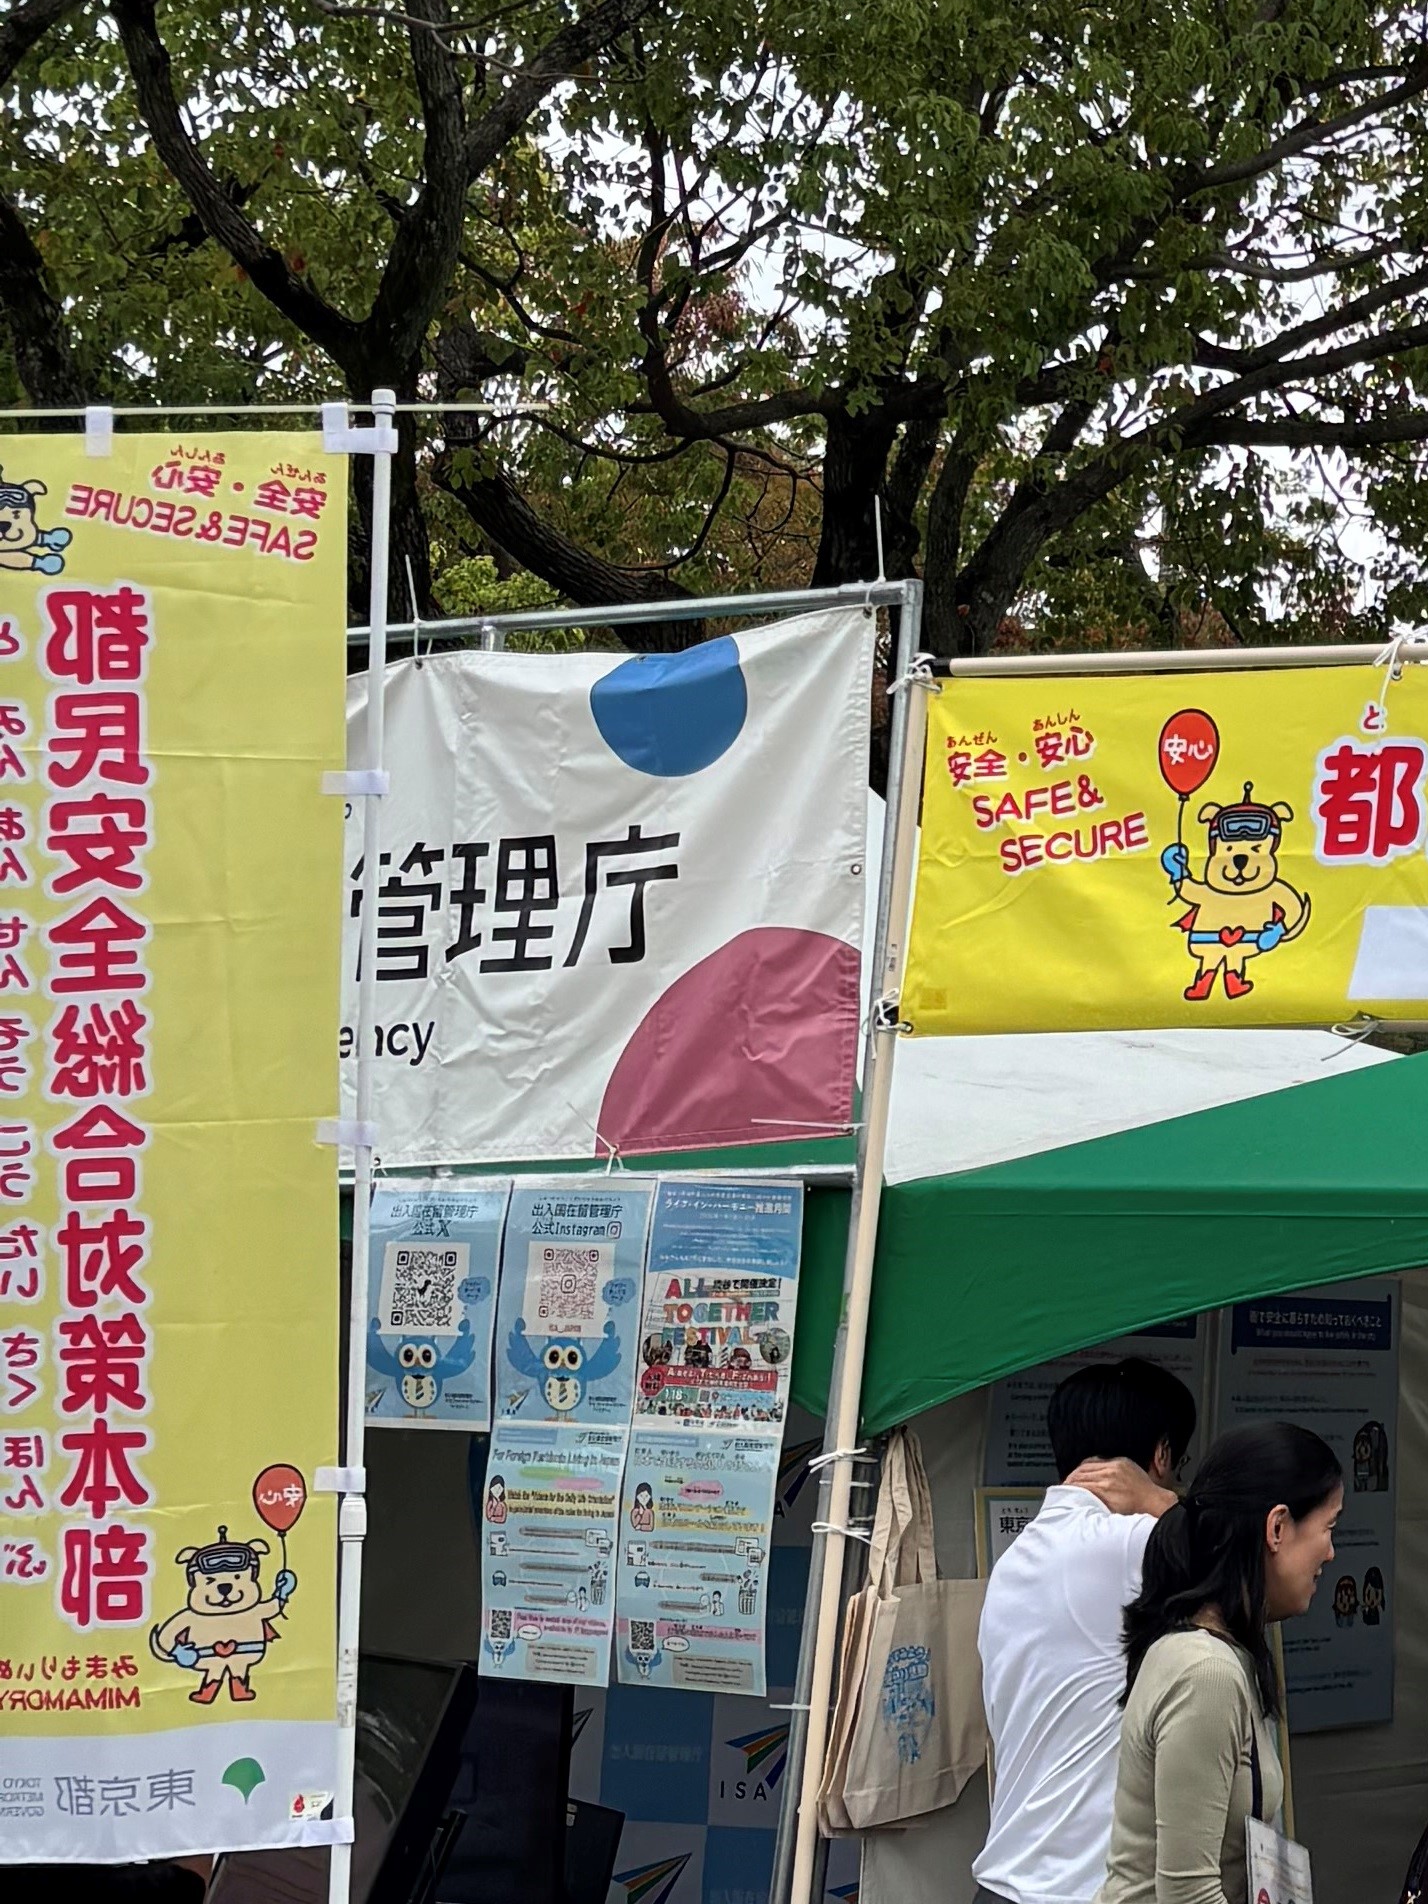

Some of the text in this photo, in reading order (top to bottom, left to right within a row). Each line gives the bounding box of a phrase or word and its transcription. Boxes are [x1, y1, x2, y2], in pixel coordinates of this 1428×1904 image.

[947, 725, 1094, 788] 安全・安心
[1163, 736, 1213, 764] 安心
[973, 773, 1106, 830] SAFE&
[1000, 812, 1149, 873] SECURE
[350, 825, 681, 982] 管理庁
[665, 1278, 711, 1299] ALL
[663, 1301, 780, 1323] TOGETHER
[662, 1326, 755, 1346] FESTIVAL
[719, 1780, 767, 1801] ISA
